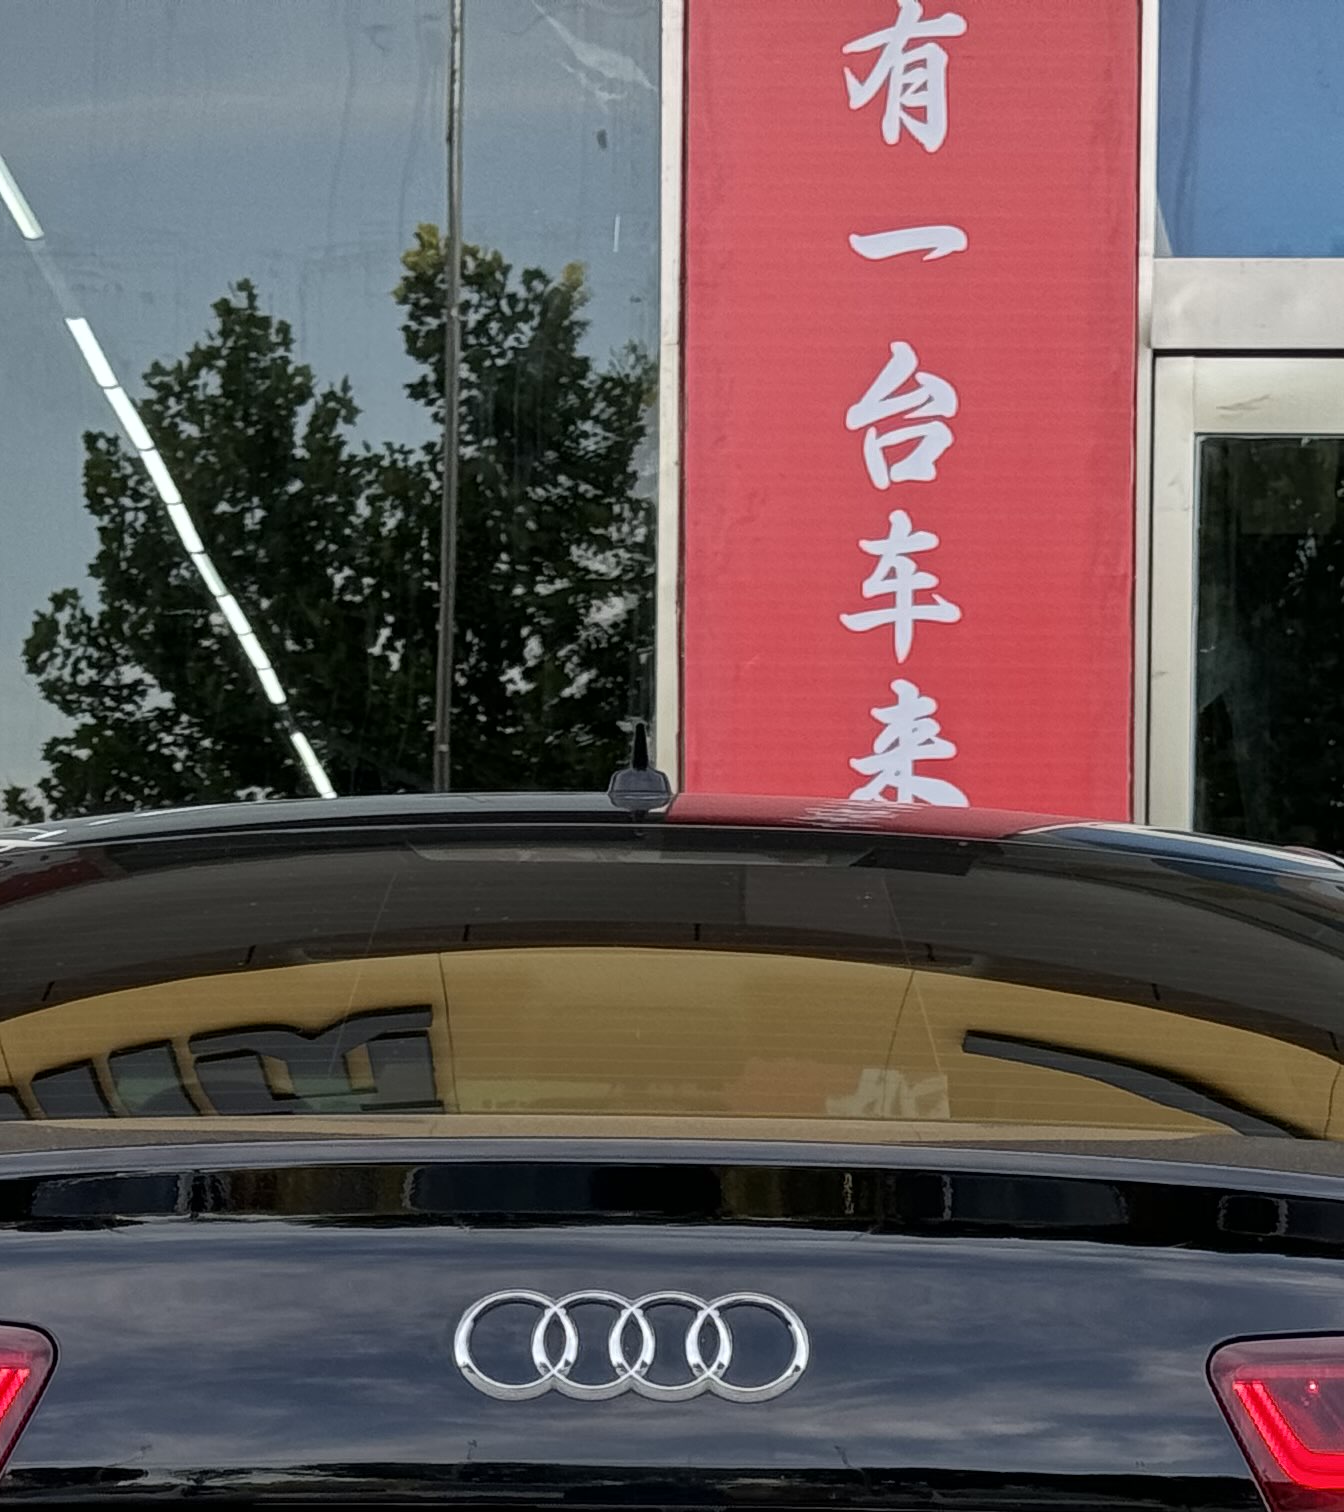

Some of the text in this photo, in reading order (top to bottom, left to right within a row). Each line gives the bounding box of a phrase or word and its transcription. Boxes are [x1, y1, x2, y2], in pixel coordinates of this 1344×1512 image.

[839, 0, 970, 808] 有一台车来
